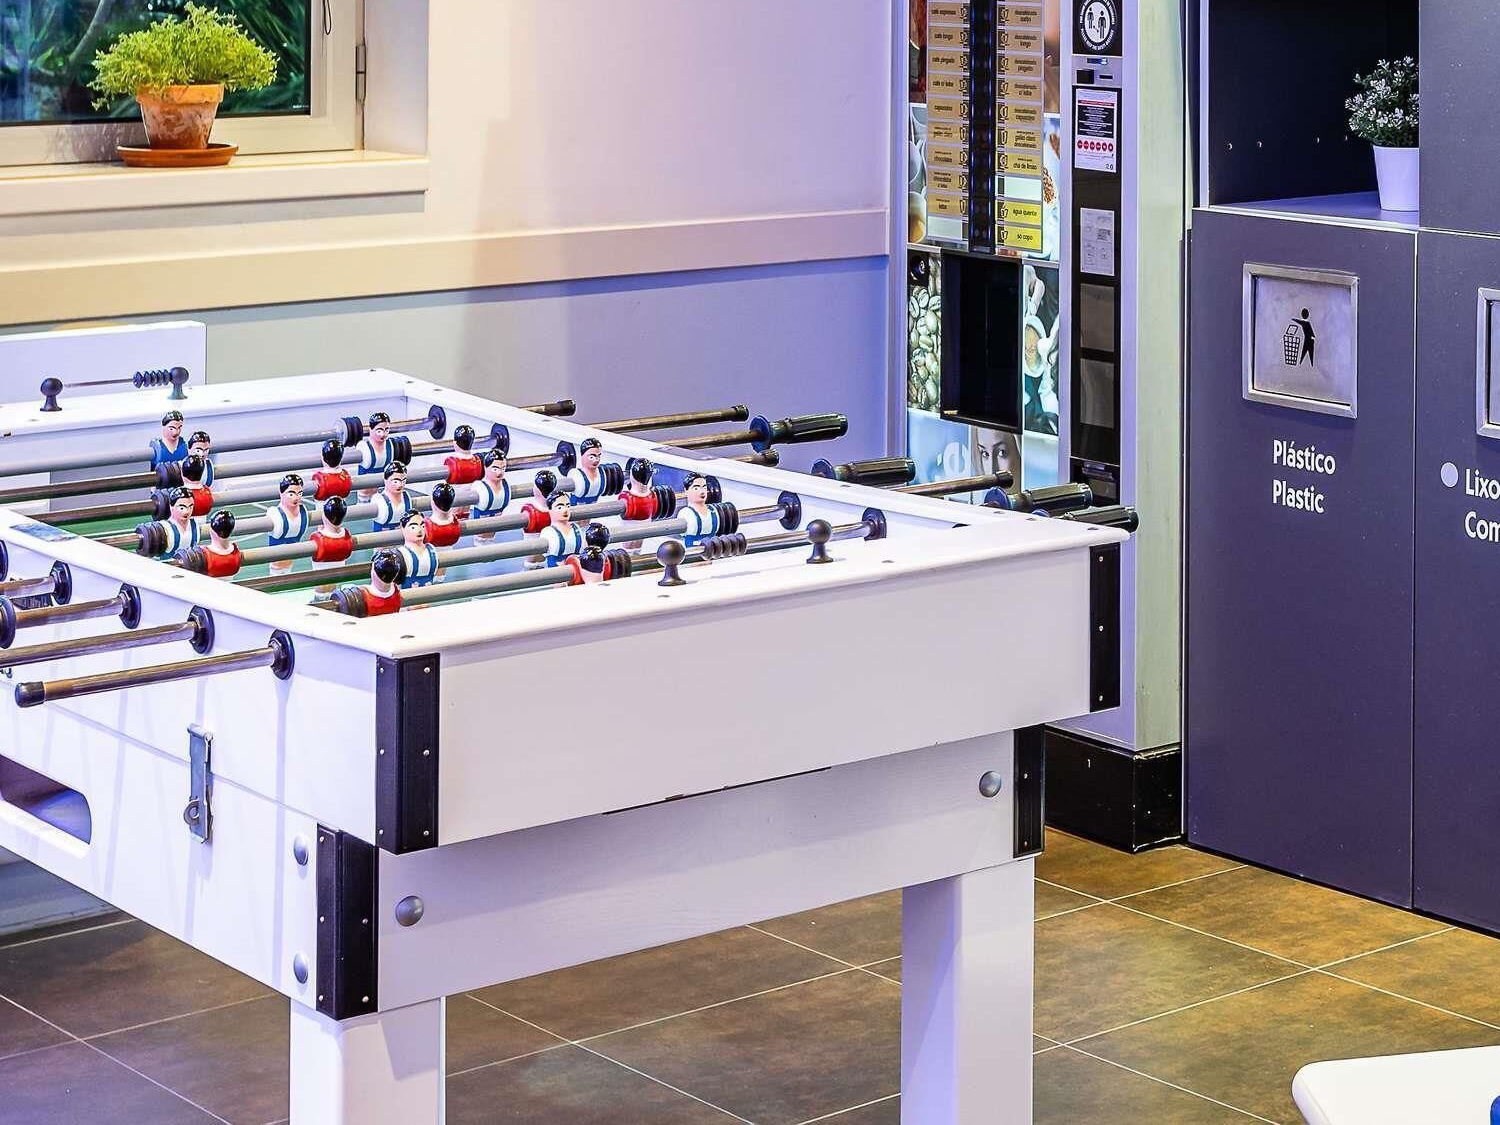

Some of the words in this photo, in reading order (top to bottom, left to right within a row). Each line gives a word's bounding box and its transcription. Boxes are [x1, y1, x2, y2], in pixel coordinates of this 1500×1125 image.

[1273, 439, 1336, 475] Plástico
[1273, 479, 1325, 514] Plastic
[1465, 468, 1500, 501] Lixo
